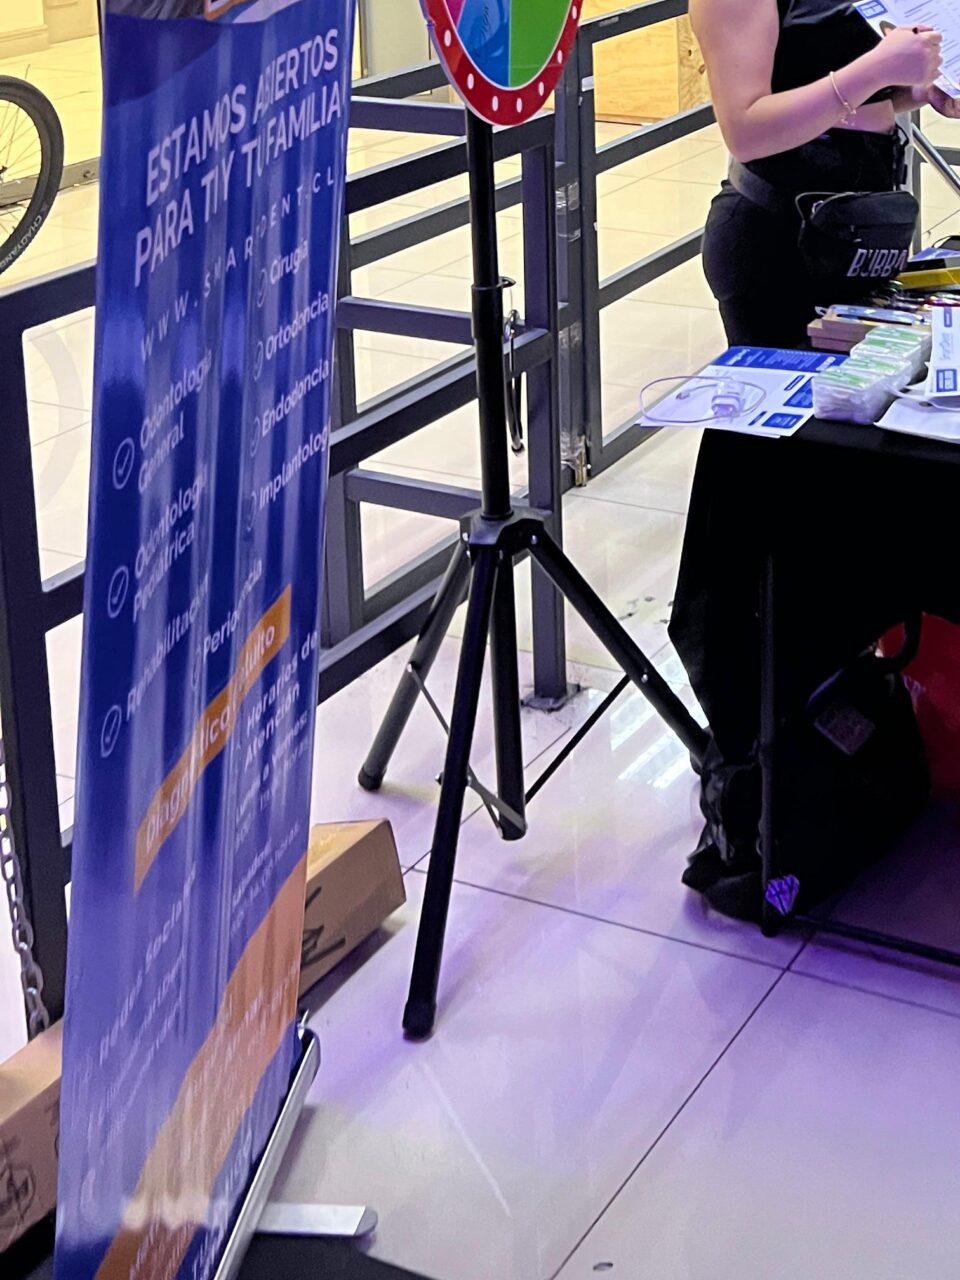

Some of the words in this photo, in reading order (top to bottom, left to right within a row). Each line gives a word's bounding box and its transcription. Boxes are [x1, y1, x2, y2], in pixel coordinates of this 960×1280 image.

[145, 82, 247, 208] ESTAMOS
[253, 28, 339, 124] ABIERTOS
[134, 187, 194, 287] PARA
[241, 136, 265, 189] TU
[264, 80, 342, 169] FAMILIA
[265, 292, 329, 362] Ortodoncia
[261, 356, 330, 438] Endodoncia
[138, 419, 185, 496] General
